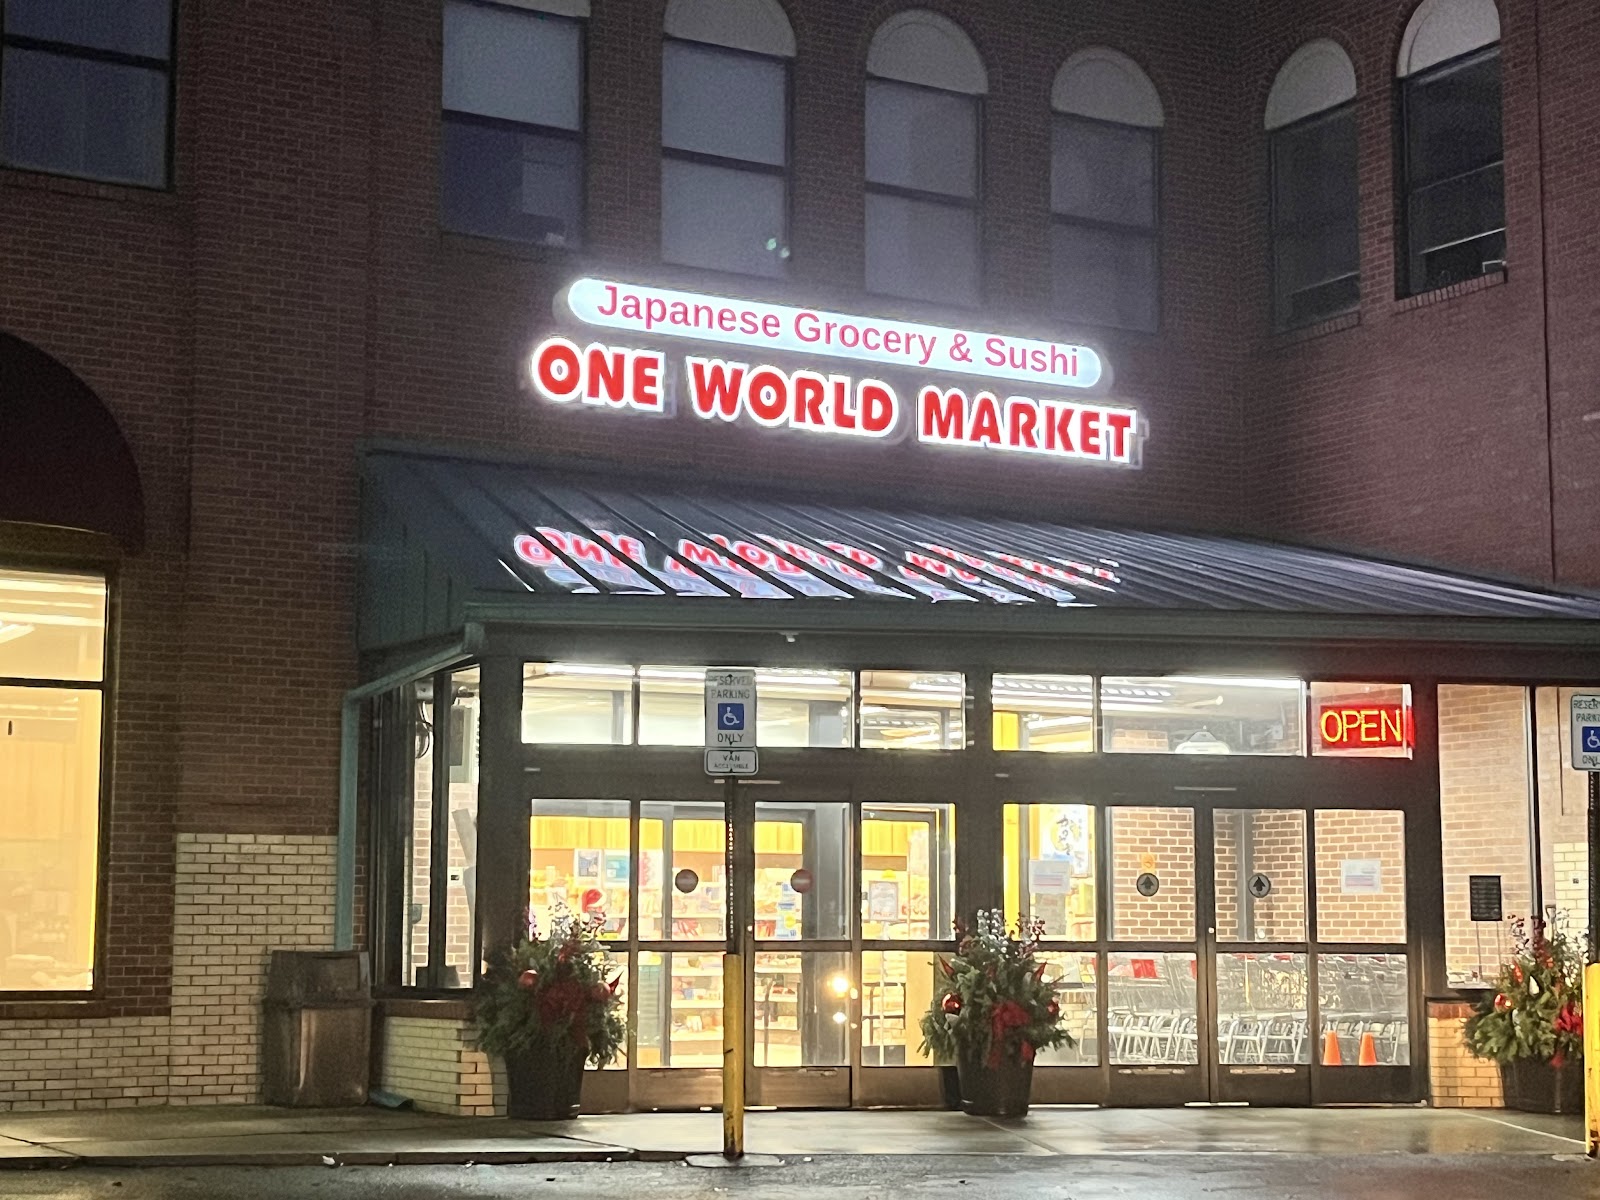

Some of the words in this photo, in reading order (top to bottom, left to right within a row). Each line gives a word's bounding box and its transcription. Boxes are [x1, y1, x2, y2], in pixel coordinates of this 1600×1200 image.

[597, 284, 781, 338] Japanese
[793, 302, 937, 365] Grocery
[948, 332, 973, 363] &
[984, 337, 1078, 377] Sushi
[537, 344, 659, 406] ONE
[691, 362, 894, 432] WORLD
[922, 390, 1132, 457] MARKET
[711, 689, 750, 699] PARKING
[1320, 709, 1402, 742] OPEN
[717, 732, 744, 743] ONLY
[723, 754, 740, 762] VAN
